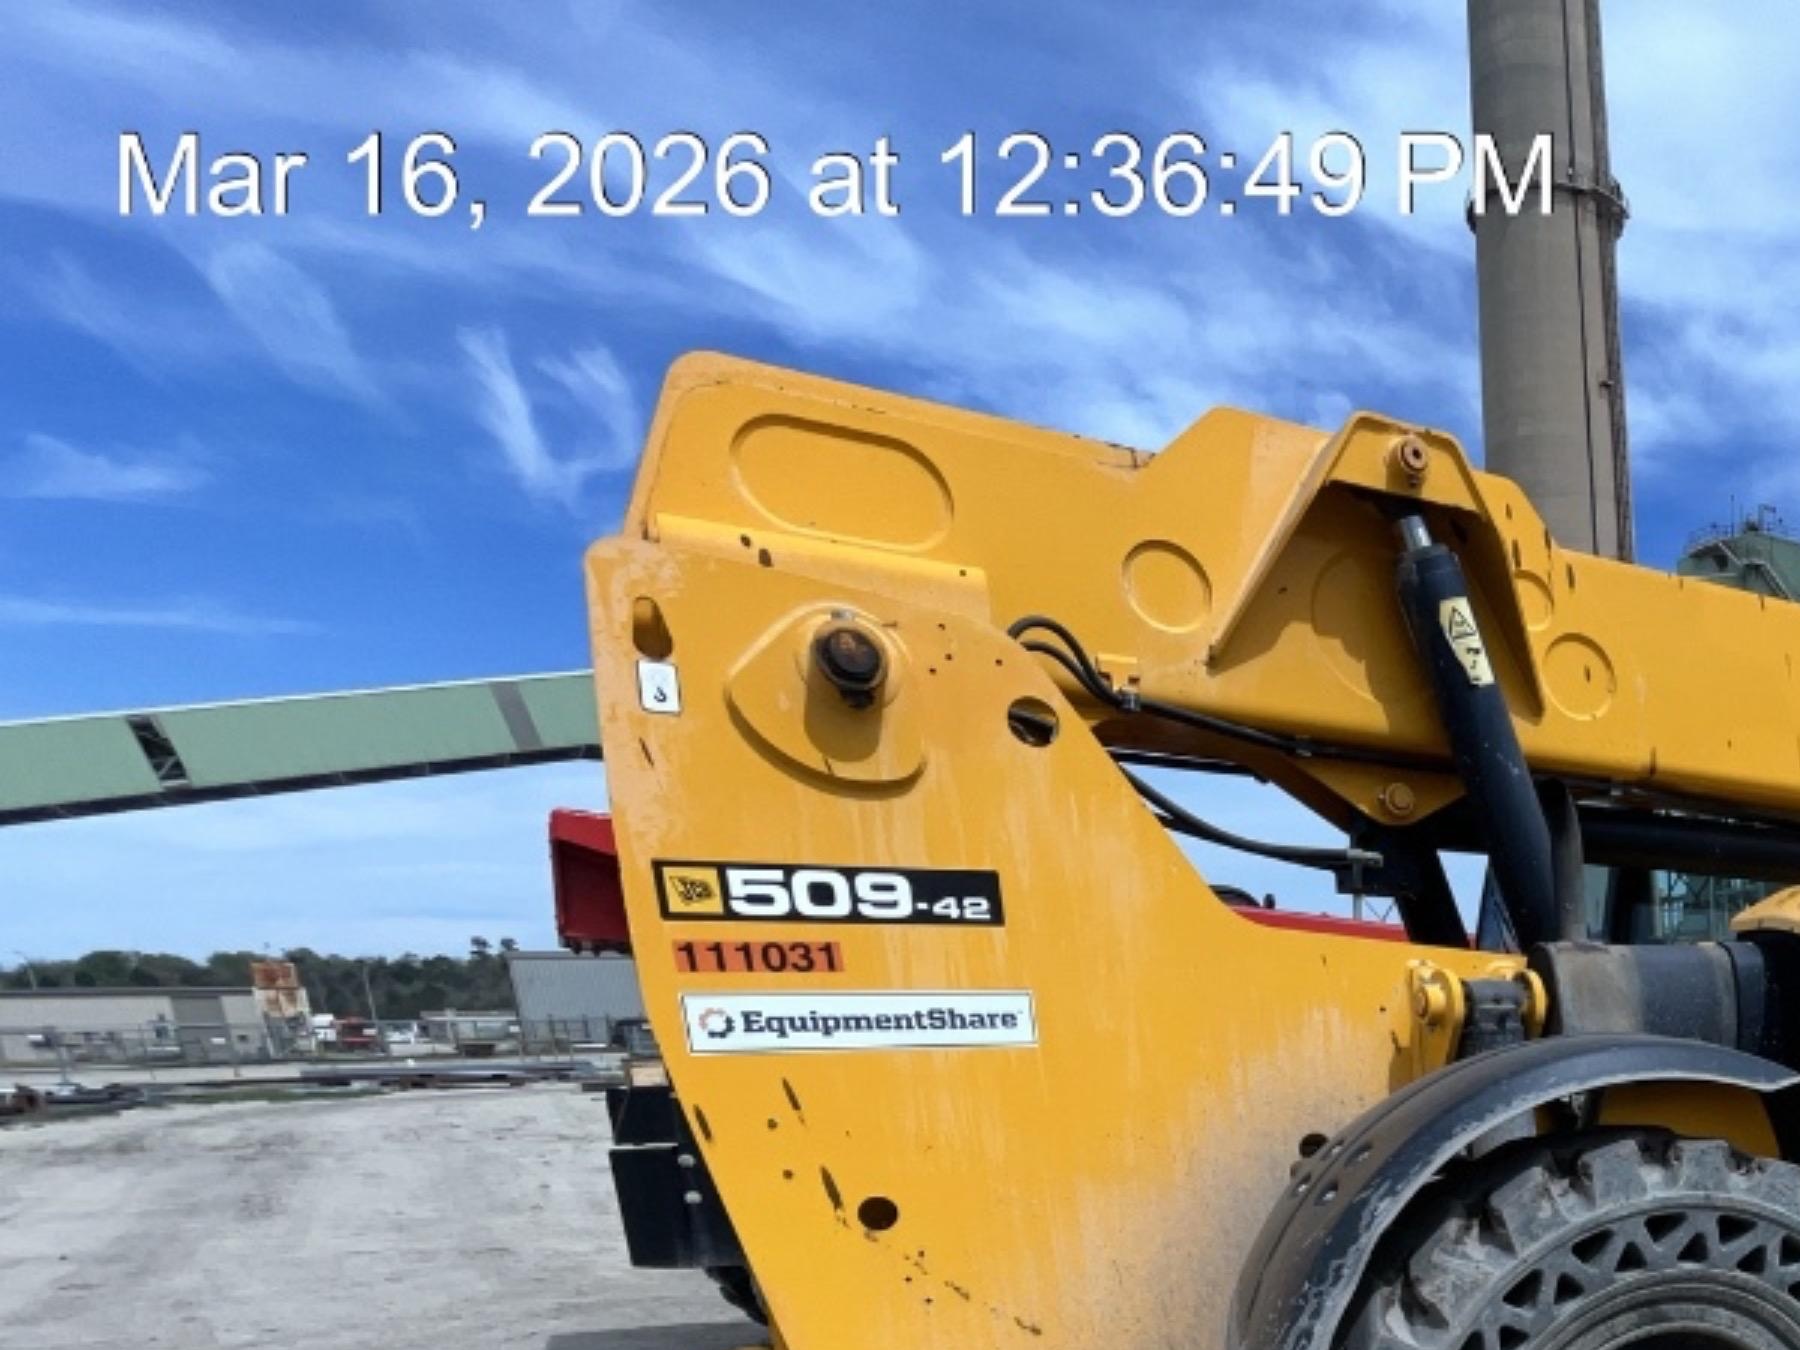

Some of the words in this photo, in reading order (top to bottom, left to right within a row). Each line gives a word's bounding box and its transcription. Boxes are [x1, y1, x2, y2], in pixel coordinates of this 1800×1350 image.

[725, 868, 991, 920] 509-42
[676, 941, 839, 973] 111031
[740, 1008, 1019, 1039] EquipmentShare
